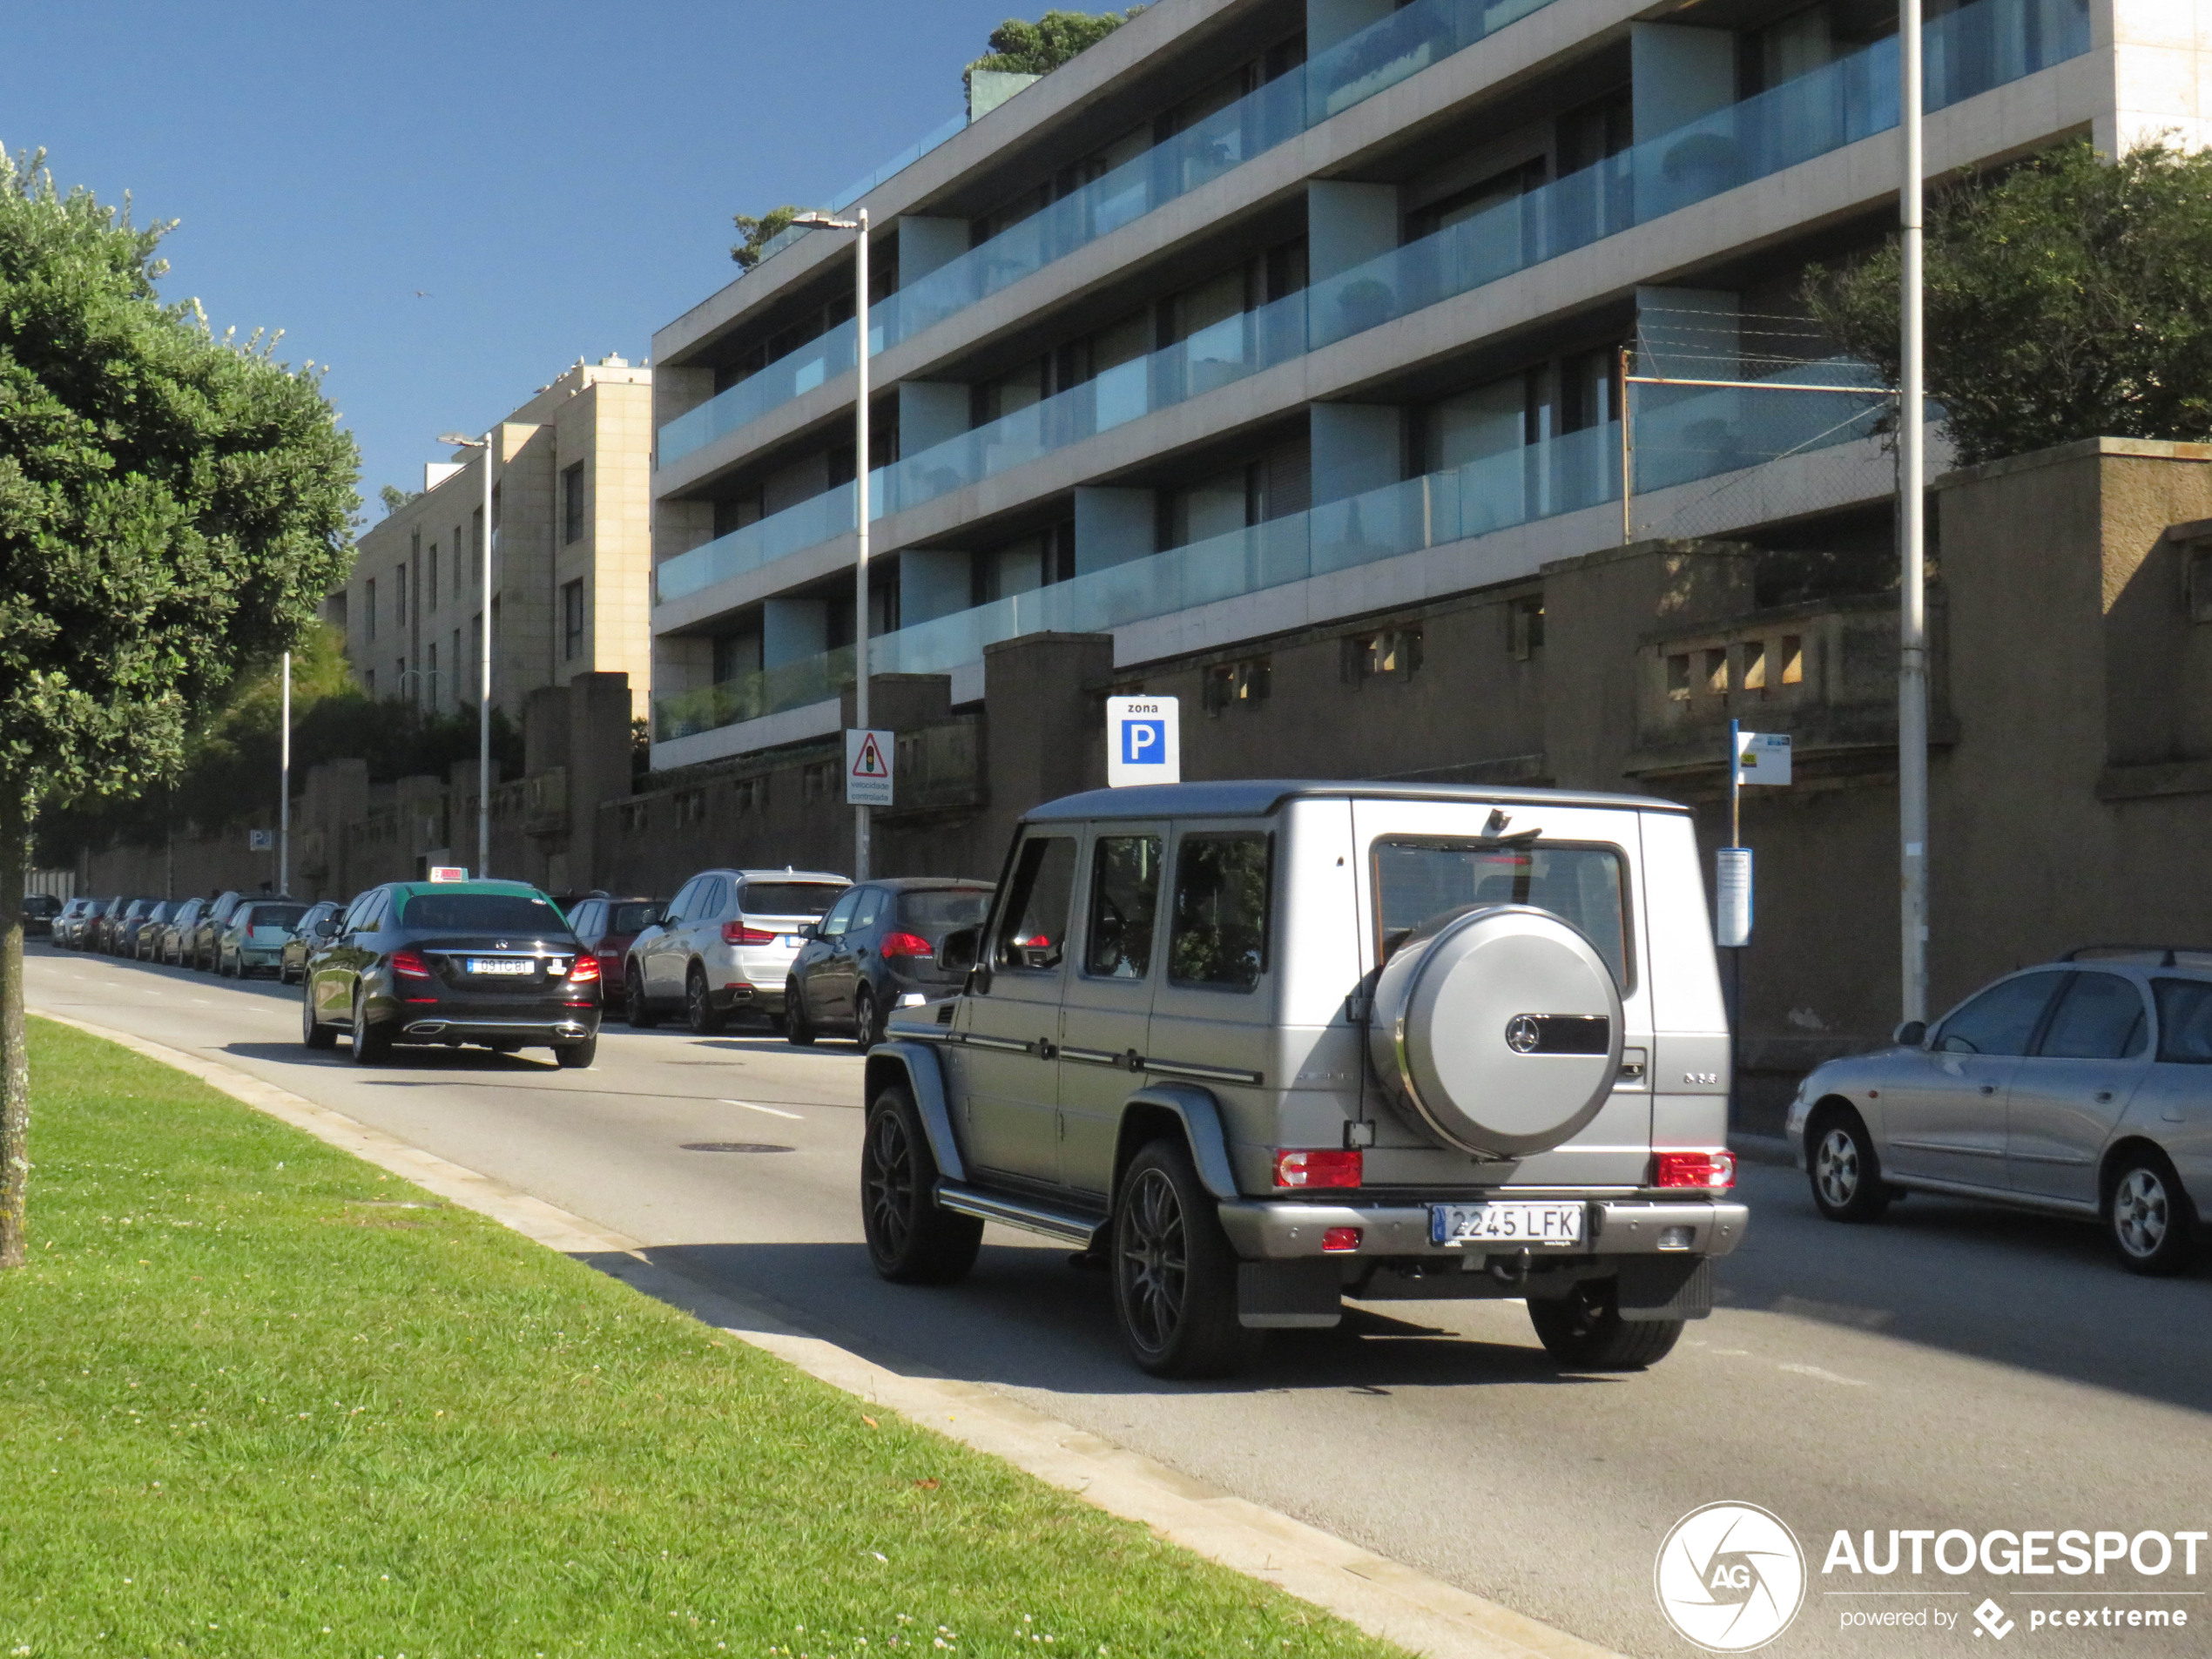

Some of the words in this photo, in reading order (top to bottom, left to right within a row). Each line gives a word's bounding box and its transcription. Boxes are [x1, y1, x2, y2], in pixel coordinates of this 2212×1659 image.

[1128, 704, 1158, 713] zona
[1130, 724, 1157, 760] P
[851, 792, 888, 801] controlada
[481, 960, 496, 971] 09
[498, 961, 513, 972] TC
[515, 961, 526, 972] 81
[1452, 1211, 1517, 1238] 2245
[1527, 1211, 1574, 1238] LFK
